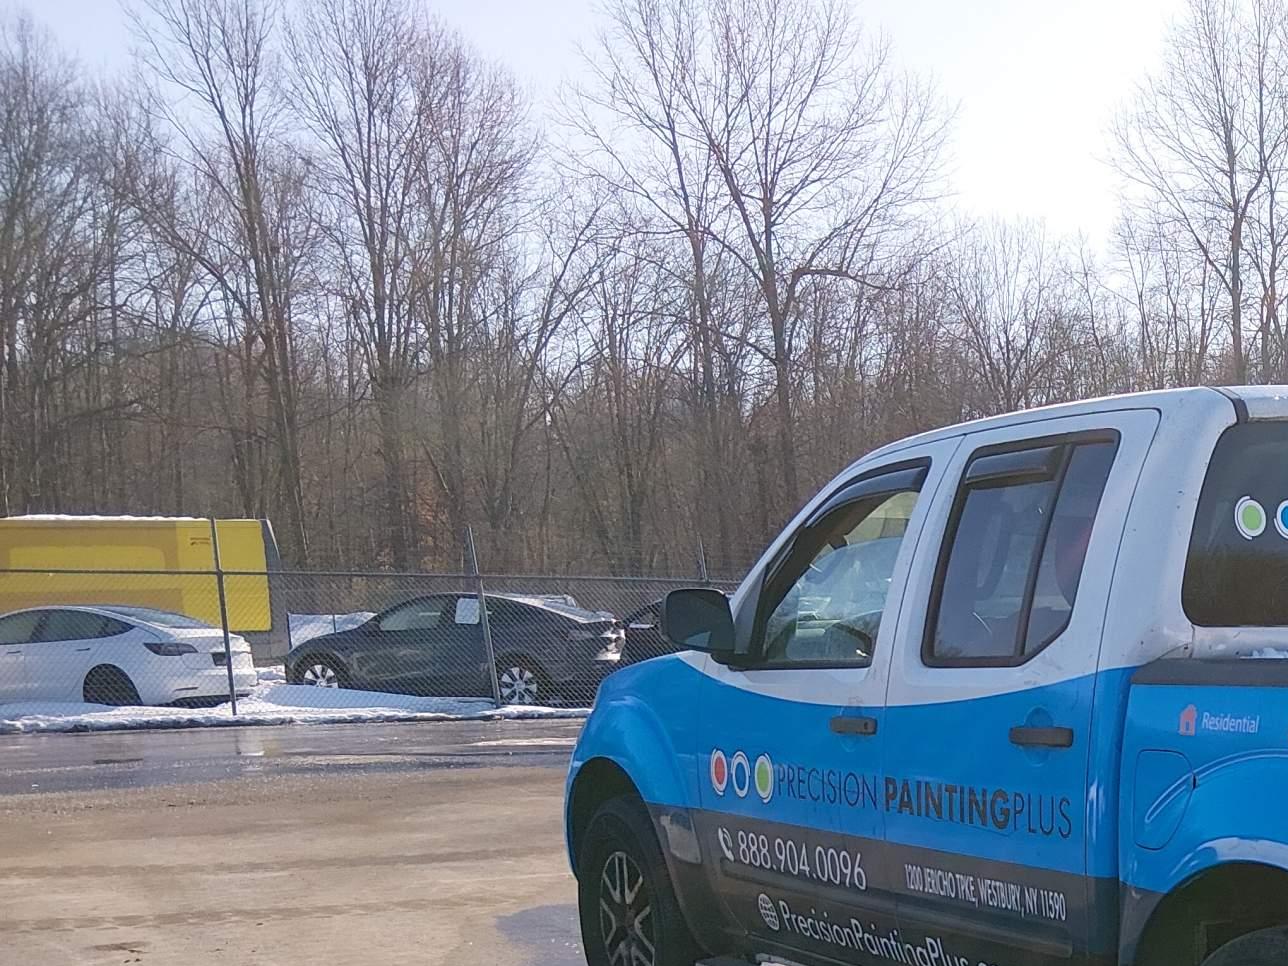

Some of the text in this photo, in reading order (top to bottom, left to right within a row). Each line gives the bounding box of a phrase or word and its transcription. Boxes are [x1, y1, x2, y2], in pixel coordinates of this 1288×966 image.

[1202, 712, 1259, 733] Residential
[777, 766, 877, 810] PRECISION
[738, 830, 867, 891] 888.904.0096
[904, 863, 923, 892] 1200
[924, 868, 955, 899] JERICHO
[978, 877, 1024, 918] WESTBURY,
[1024, 886, 1038, 915] NY
[1040, 889, 1066, 921] 11590
